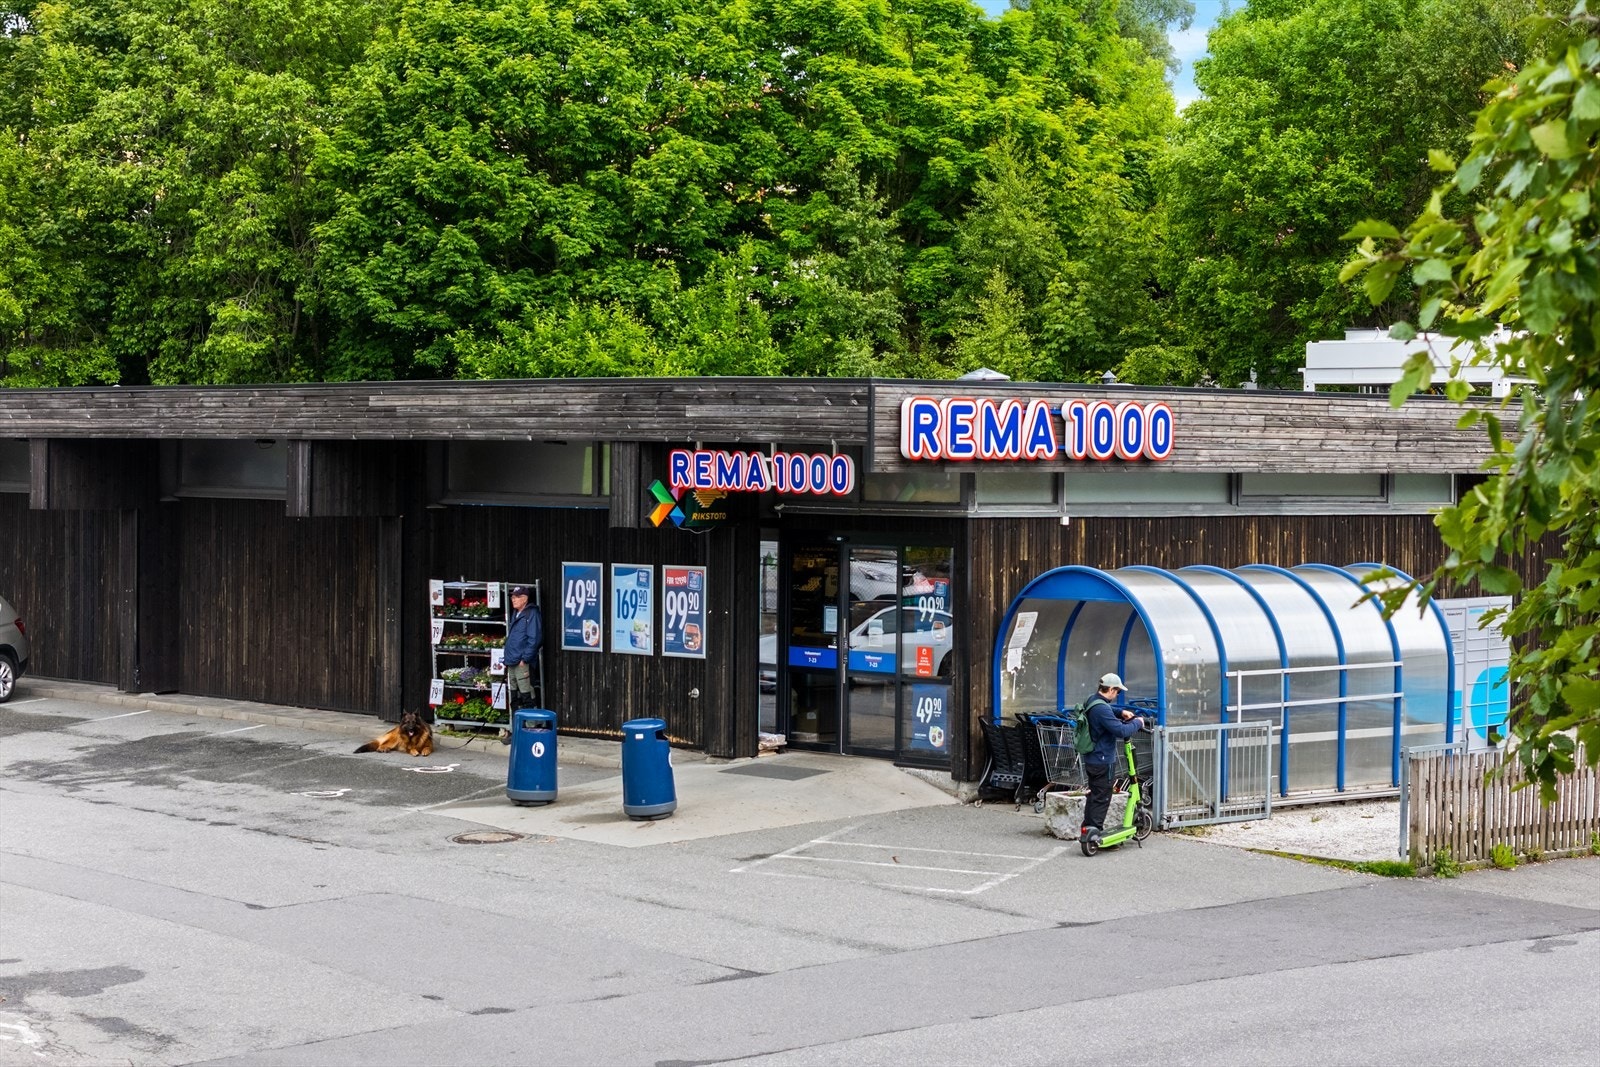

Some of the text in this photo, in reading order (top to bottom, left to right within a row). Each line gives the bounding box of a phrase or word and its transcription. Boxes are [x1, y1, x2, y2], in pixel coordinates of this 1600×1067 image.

[902, 397, 1175, 461] REMA 1000
[670, 450, 855, 496] REMA 1000
[691, 512, 727, 521] RIKSTOTO
